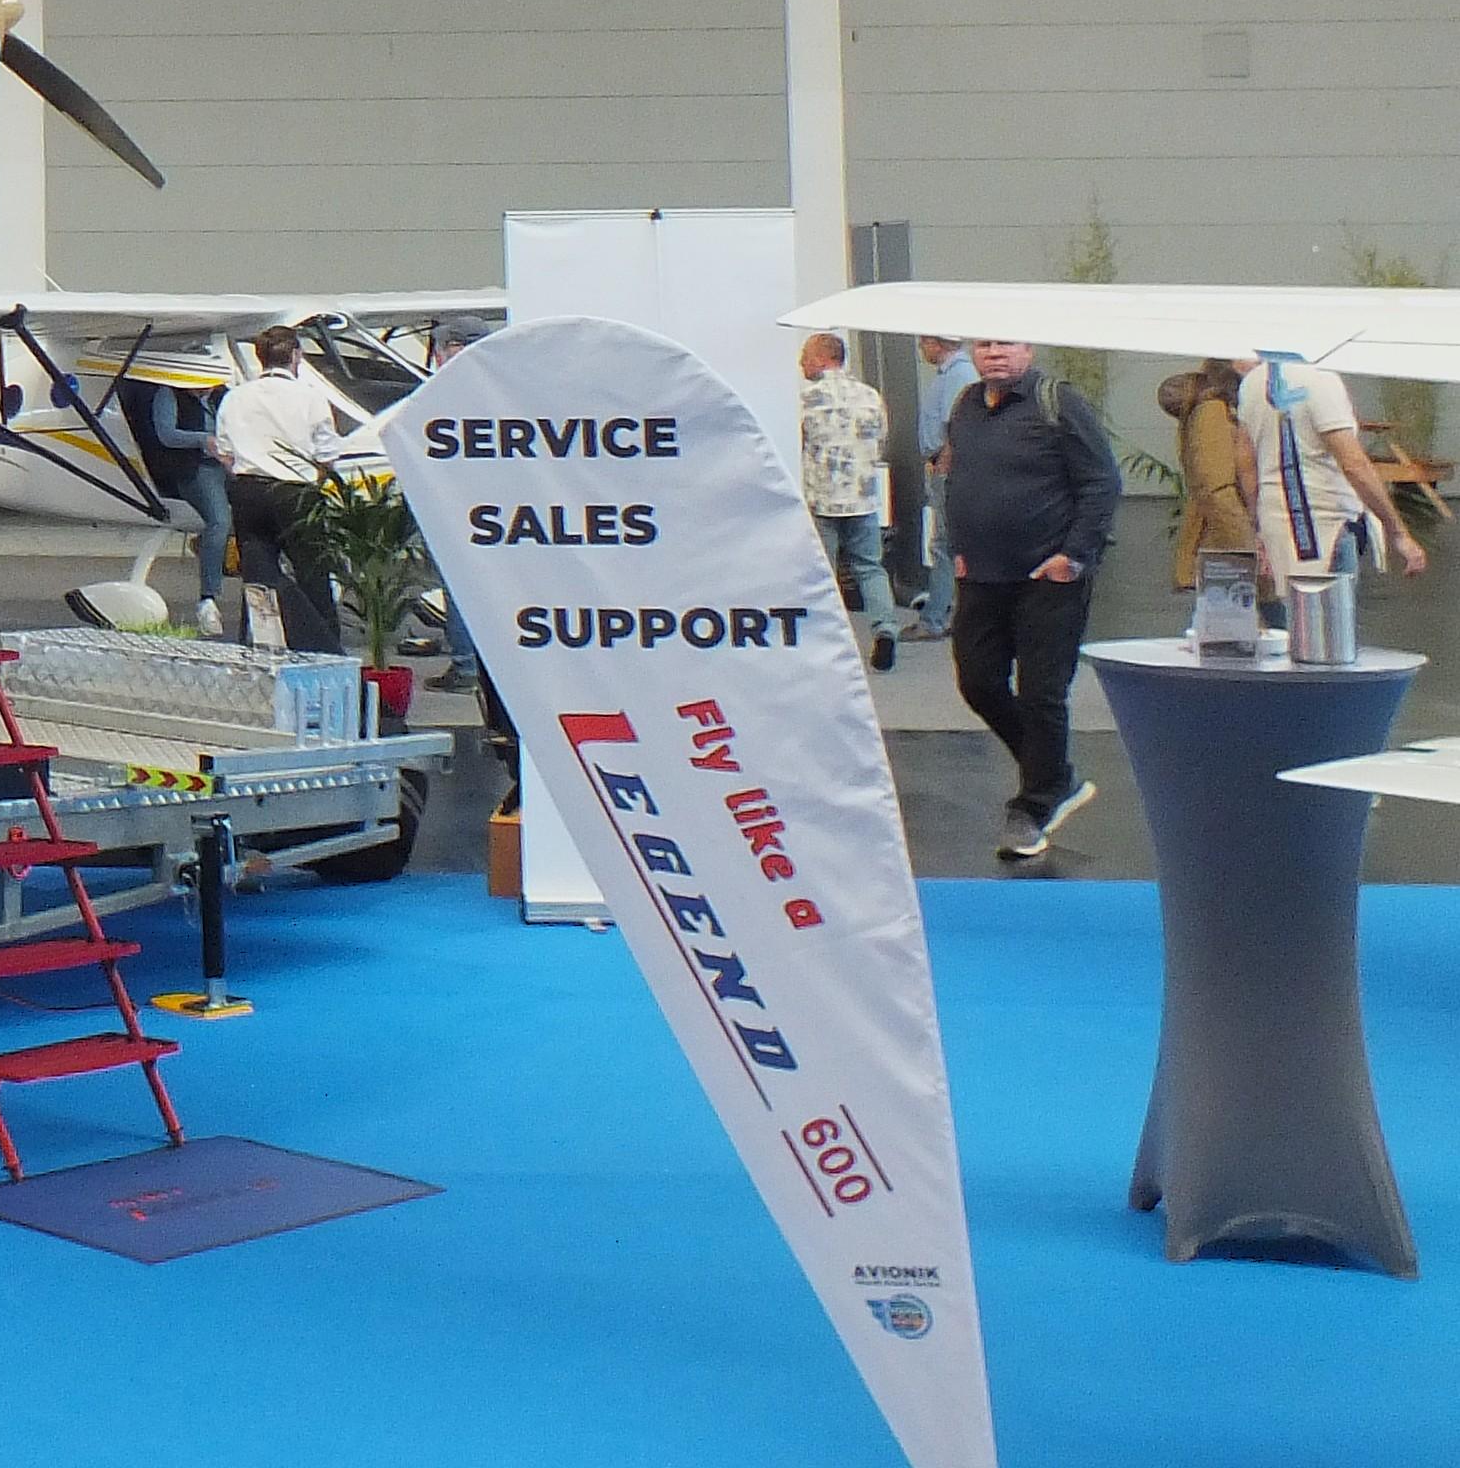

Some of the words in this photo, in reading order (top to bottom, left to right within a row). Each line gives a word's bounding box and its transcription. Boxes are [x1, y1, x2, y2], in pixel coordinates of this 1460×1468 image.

[424, 417, 679, 460] SERVICE
[469, 504, 658, 547] SALES
[516, 606, 808, 649] SUPPORT
[676, 698, 743, 773] Fly
[724, 788, 796, 883] like
[784, 898, 825, 930] a
[558, 712, 799, 1111] LEGEND
[800, 1117, 872, 1206] 600
